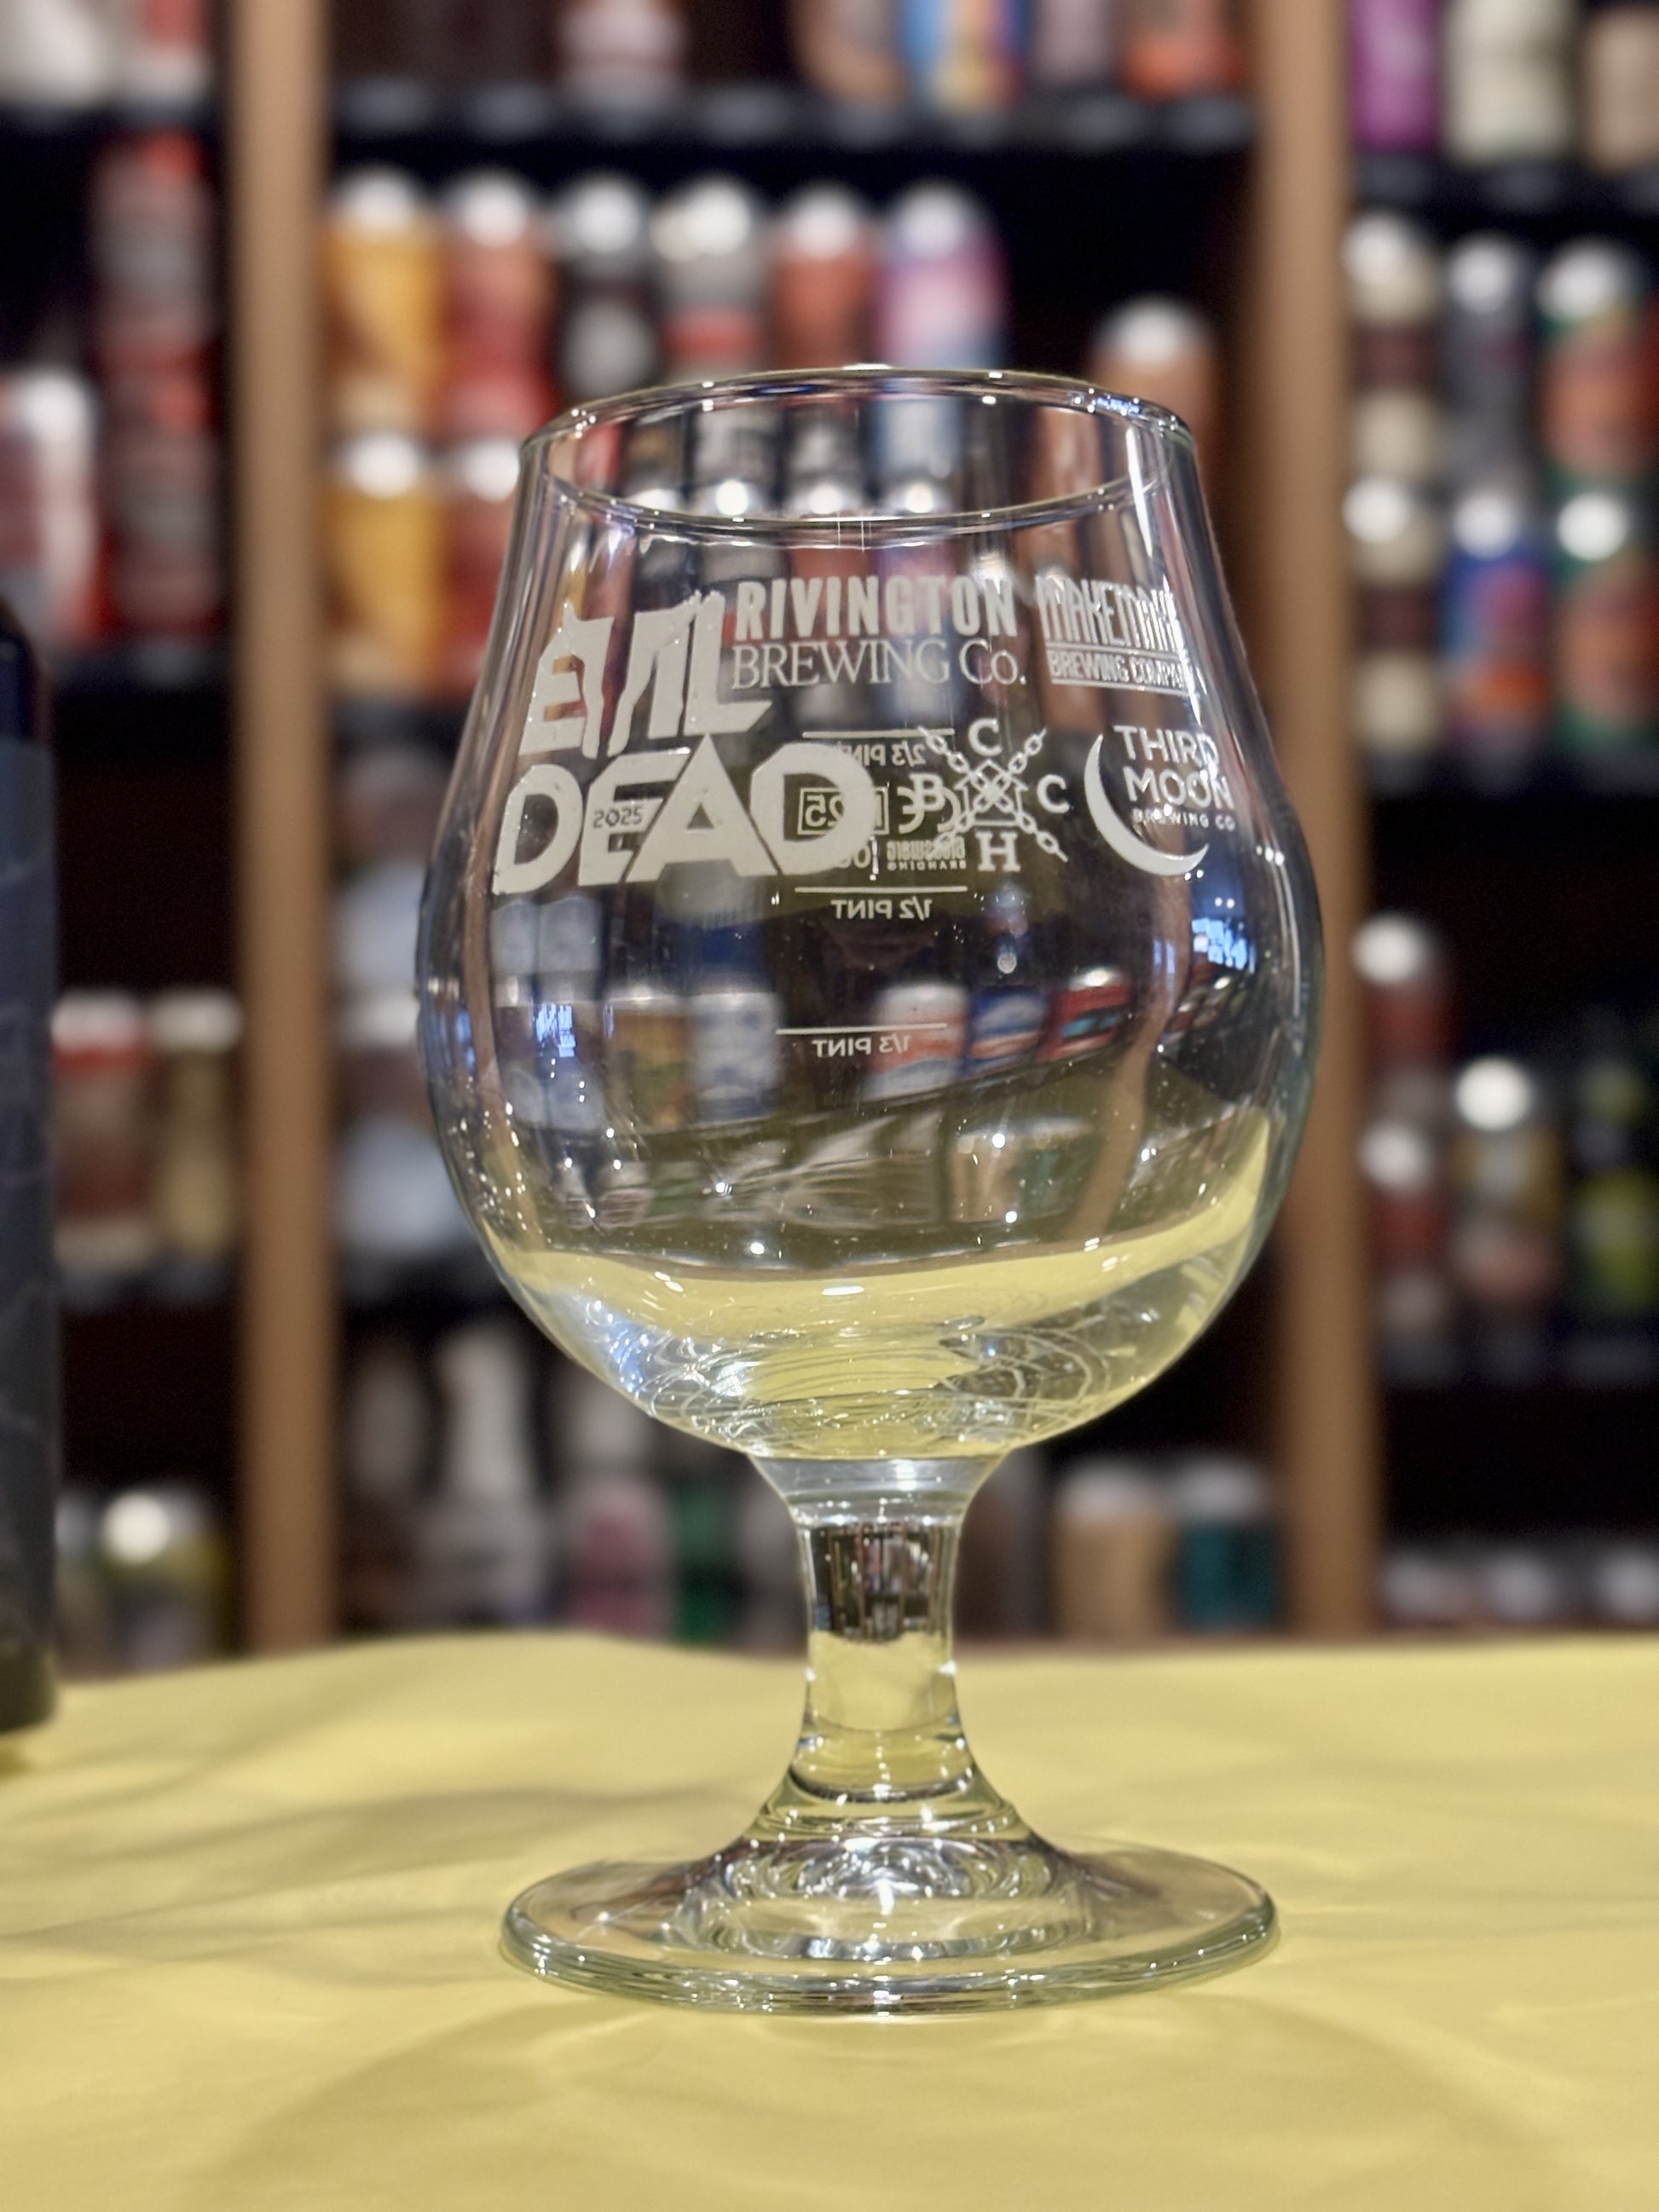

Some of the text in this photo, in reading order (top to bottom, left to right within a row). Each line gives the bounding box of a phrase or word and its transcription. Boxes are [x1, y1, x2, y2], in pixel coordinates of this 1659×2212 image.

[735, 575, 1017, 640] RIVINGTON
[1035, 575, 1185, 653] MAKEMAK
[731, 640, 951, 690] BREWING
[1048, 650, 1130, 682] BREWING
[1113, 725, 1220, 767] THIRD
[1123, 767, 1236, 810] MOON
[492, 733, 876, 896] DEAD
[592, 805, 645, 829] 2025
